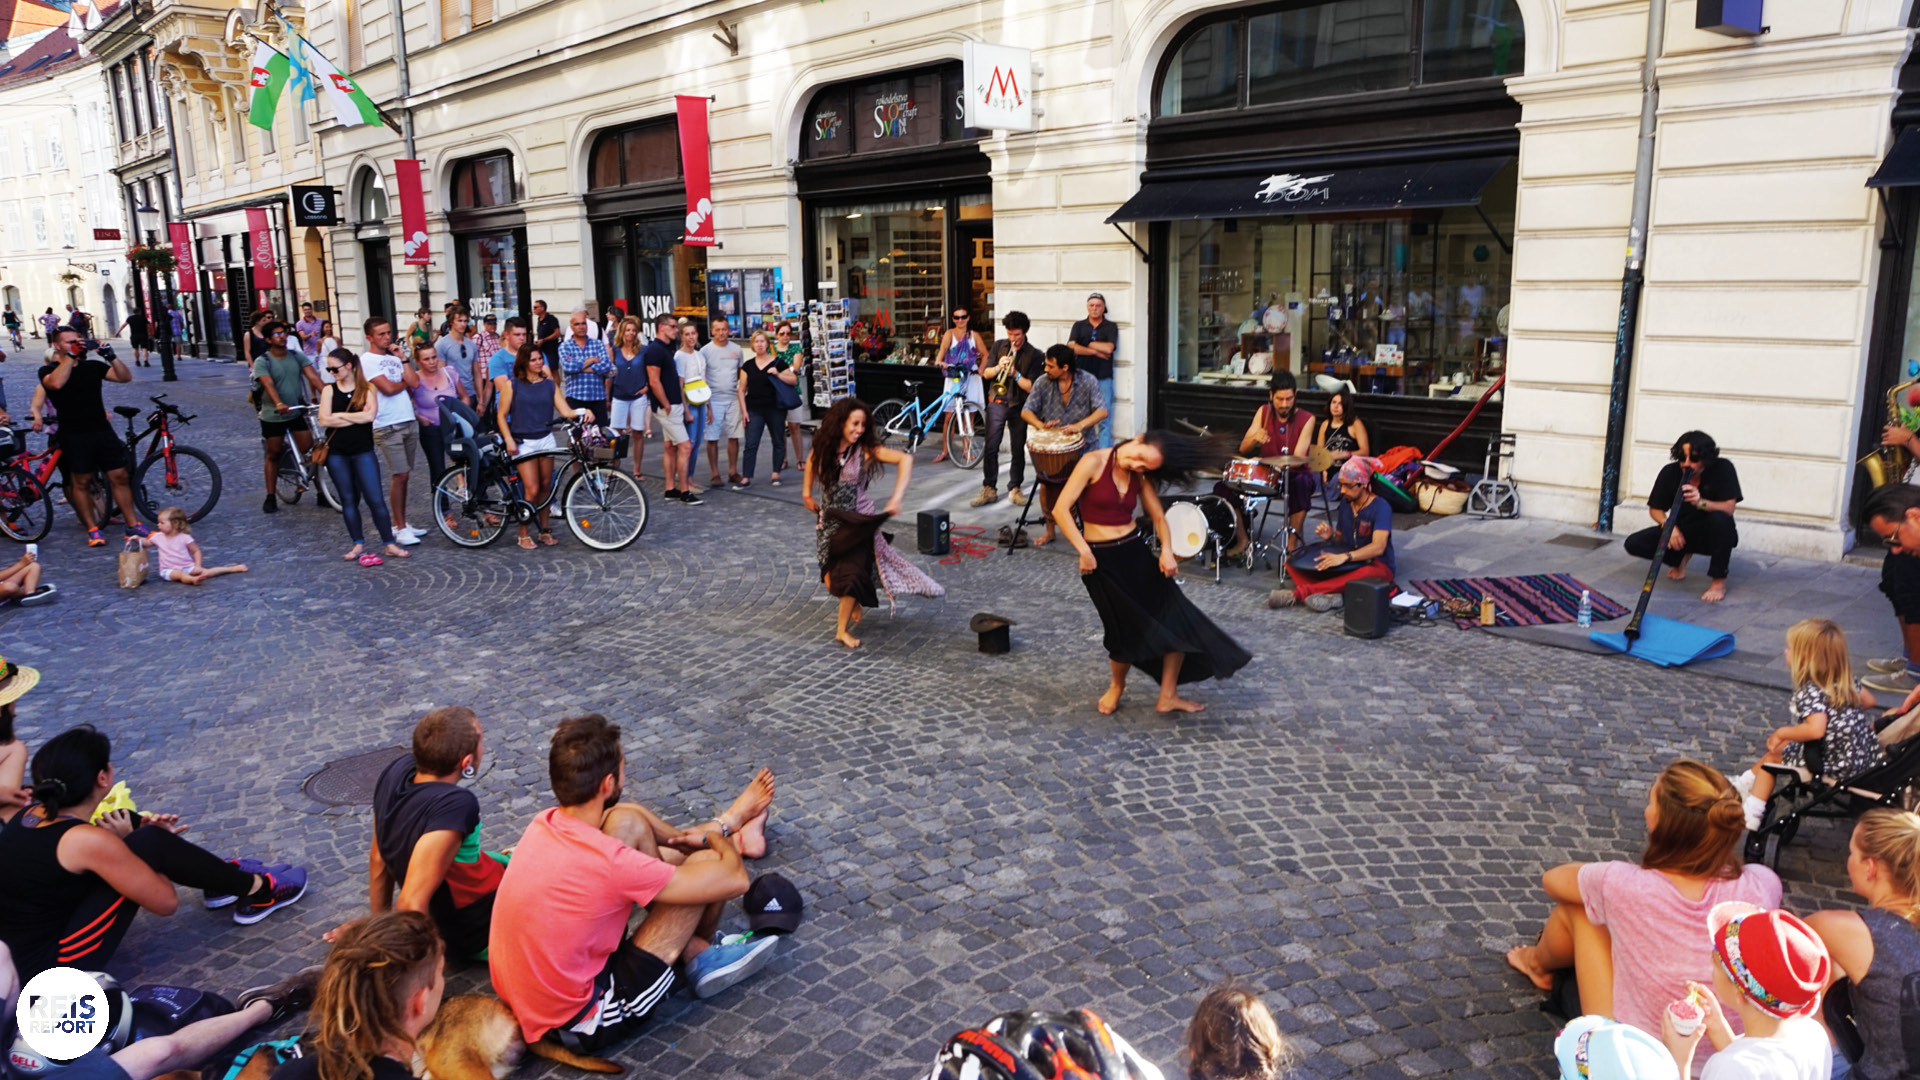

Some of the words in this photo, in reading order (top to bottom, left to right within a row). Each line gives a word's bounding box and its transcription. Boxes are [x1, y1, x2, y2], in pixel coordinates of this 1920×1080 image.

[255, 230, 272, 270] s.Oliver
[640, 295, 671, 319] VSAK
[11, 1053, 40, 1069] BELL
